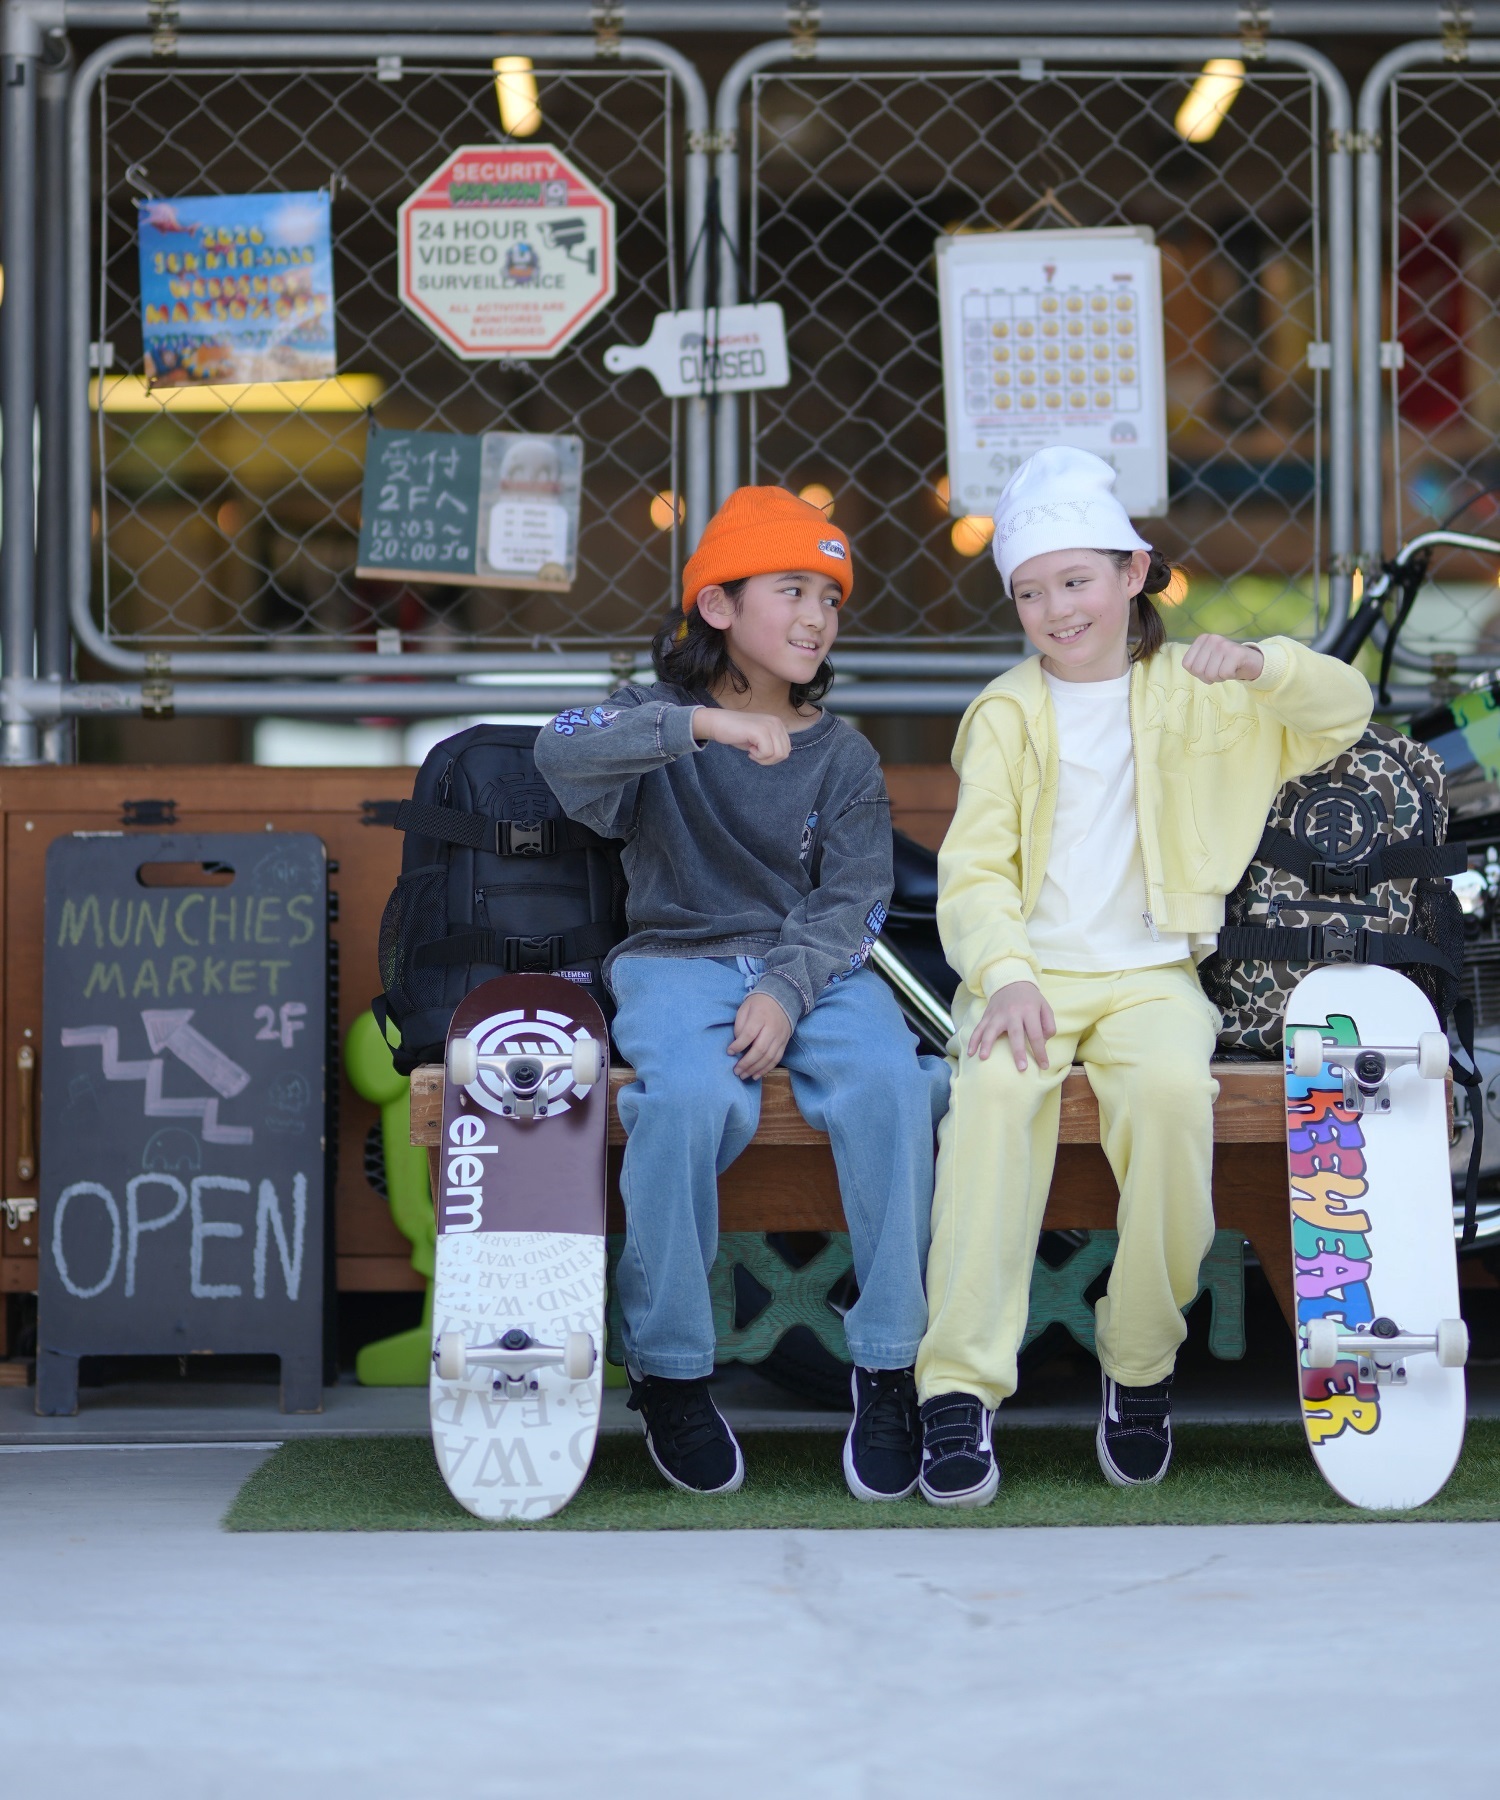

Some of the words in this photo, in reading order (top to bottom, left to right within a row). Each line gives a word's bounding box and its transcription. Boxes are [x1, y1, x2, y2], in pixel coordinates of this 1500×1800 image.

[453, 162, 558, 181] SECURITY
[418, 222, 446, 240] 24
[453, 220, 527, 240] HOUR
[418, 245, 498, 265] VIDEO
[679, 349, 766, 384] CLOSED
[381, 437, 461, 483] 受付
[58, 893, 316, 946] MUNCHIES
[84, 956, 291, 999] MARKET
[560, 970, 590, 979] ELEMENT
[254, 1002, 308, 1049] 2F
[52, 1171, 308, 1302] OPEN
